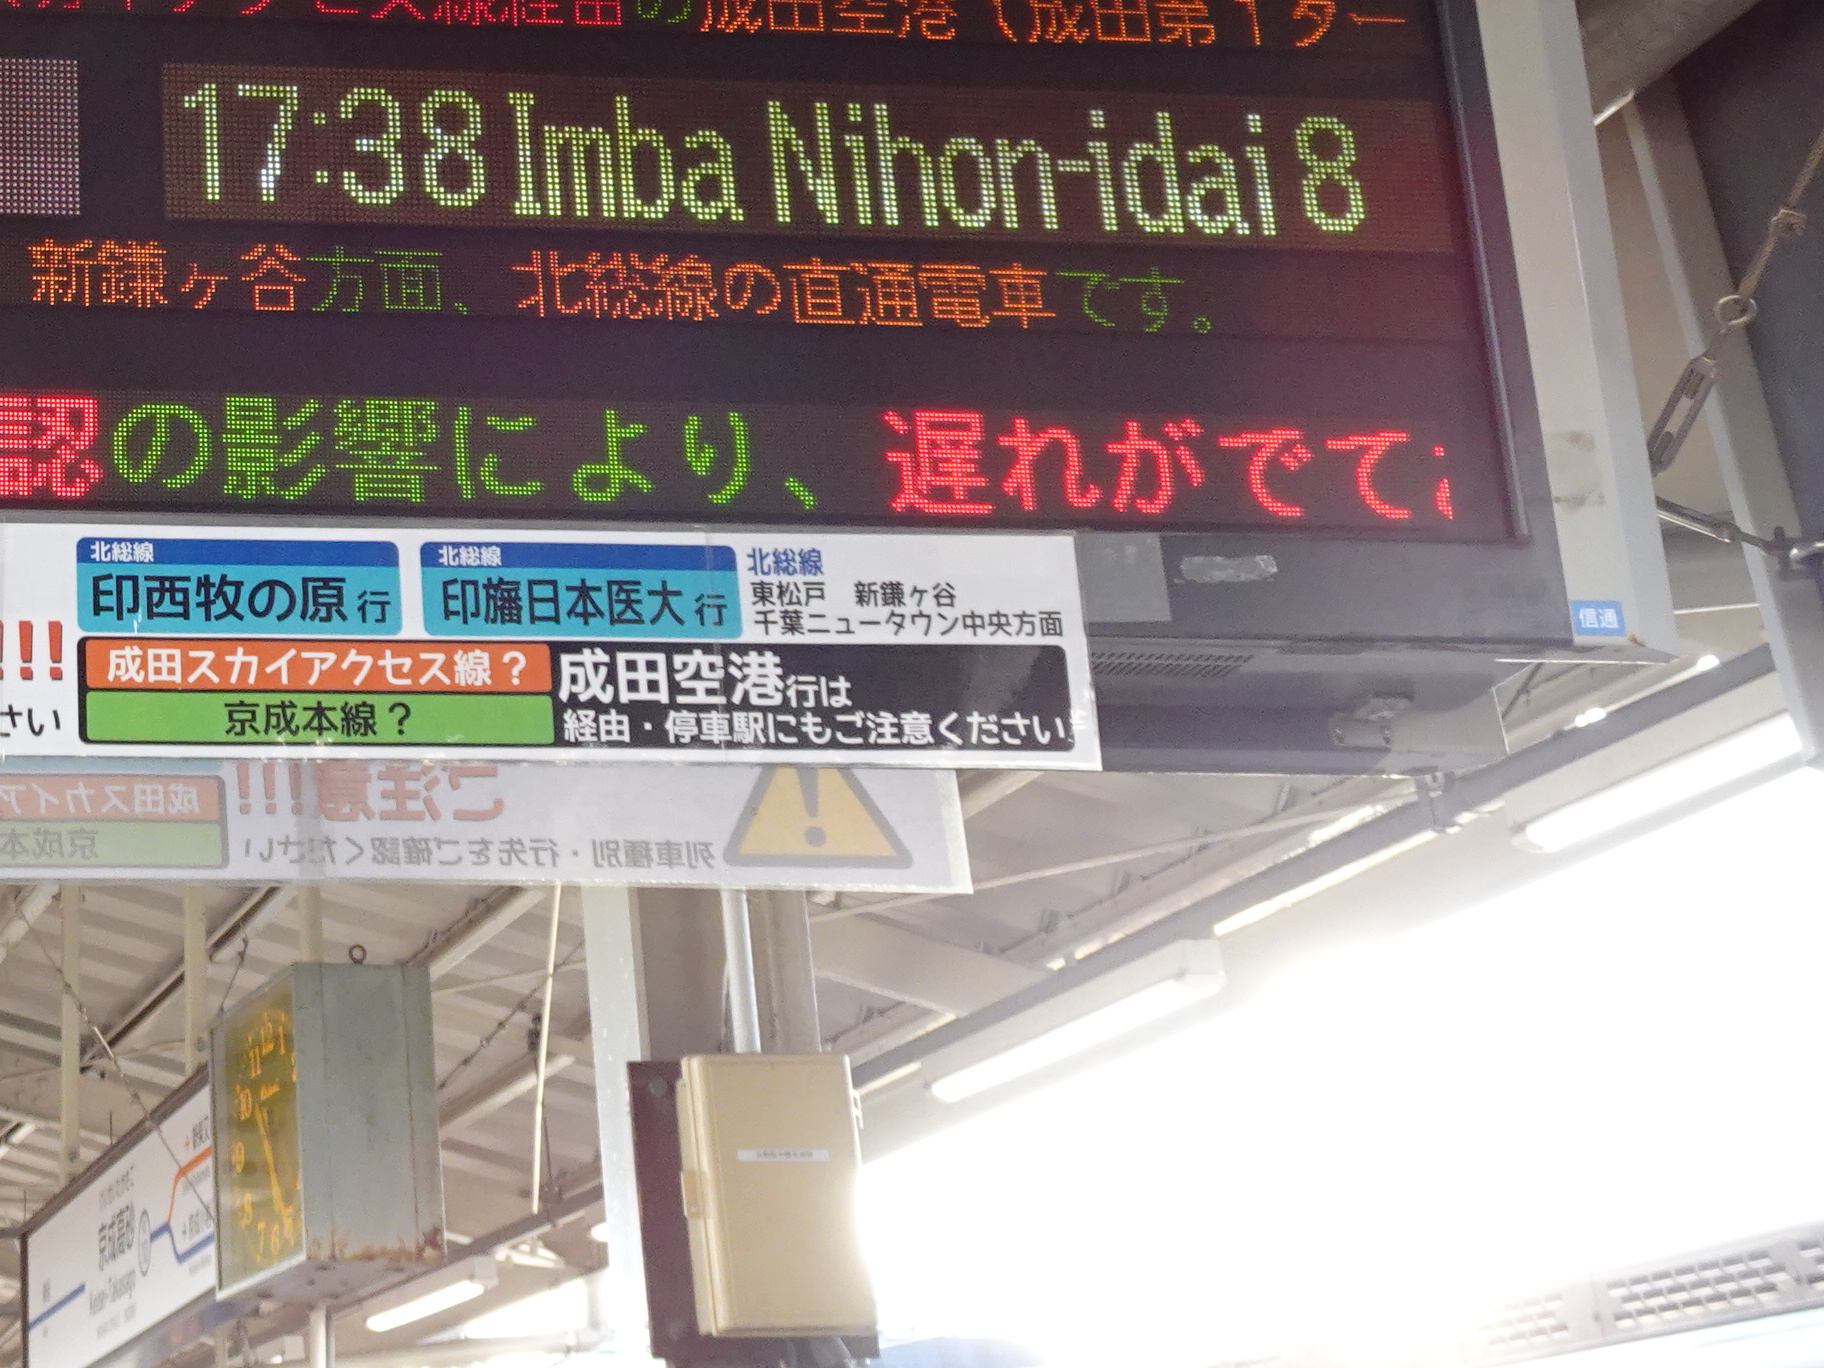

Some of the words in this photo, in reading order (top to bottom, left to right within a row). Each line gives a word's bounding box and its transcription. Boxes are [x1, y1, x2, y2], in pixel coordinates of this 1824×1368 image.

[183, 82, 487, 209] 17:38
[507, 91, 745, 223] Imba
[766, 99, 1278, 237] Nihon-idai
[1293, 114, 1367, 234] 8
[90, 540, 156, 564] 北総線
[437, 544, 504, 567] 北総線
[746, 547, 825, 577] 北総線
[750, 580, 826, 608] 東松戸
[753, 609, 1064, 639] 千葉ニュータウン中央方面
[1578, 606, 1620, 630] 信通
[563, 710, 1066, 747] 経由・停車駅にもご注意ください
